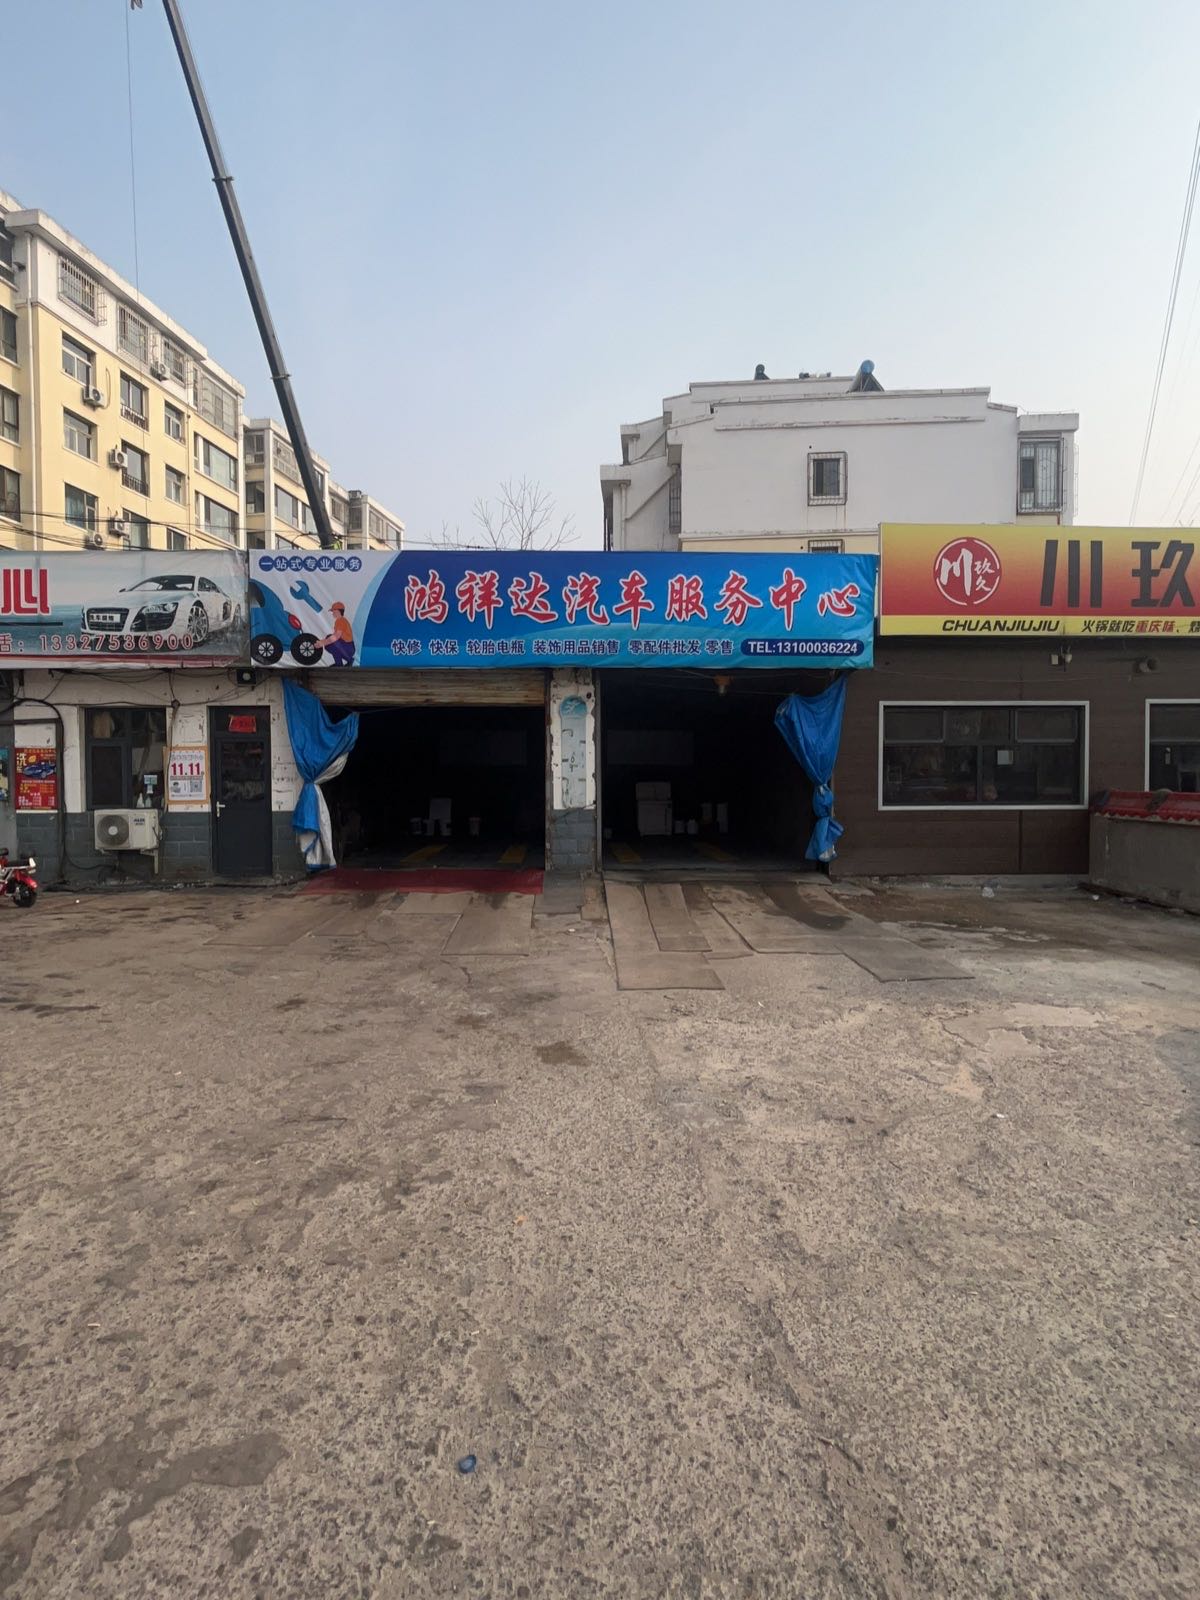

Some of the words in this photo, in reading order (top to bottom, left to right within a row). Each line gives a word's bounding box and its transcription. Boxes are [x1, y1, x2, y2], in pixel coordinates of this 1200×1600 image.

[259, 556, 362, 572] 一站式专业服务
[402, 567, 861, 631] 鸿祥达汽车服务中心
[942, 619, 1061, 633] CHUANJIUJIU
[391, 638, 421, 656] 快修
[430, 638, 459, 656] 快保
[466, 638, 525, 656] 轮胎电瓶
[532, 638, 620, 656] 装饰用品销售
[629, 638, 701, 655] 零配件批发
[705, 638, 734, 655] 零售
[748, 640, 858, 654] TEL:13100036224
